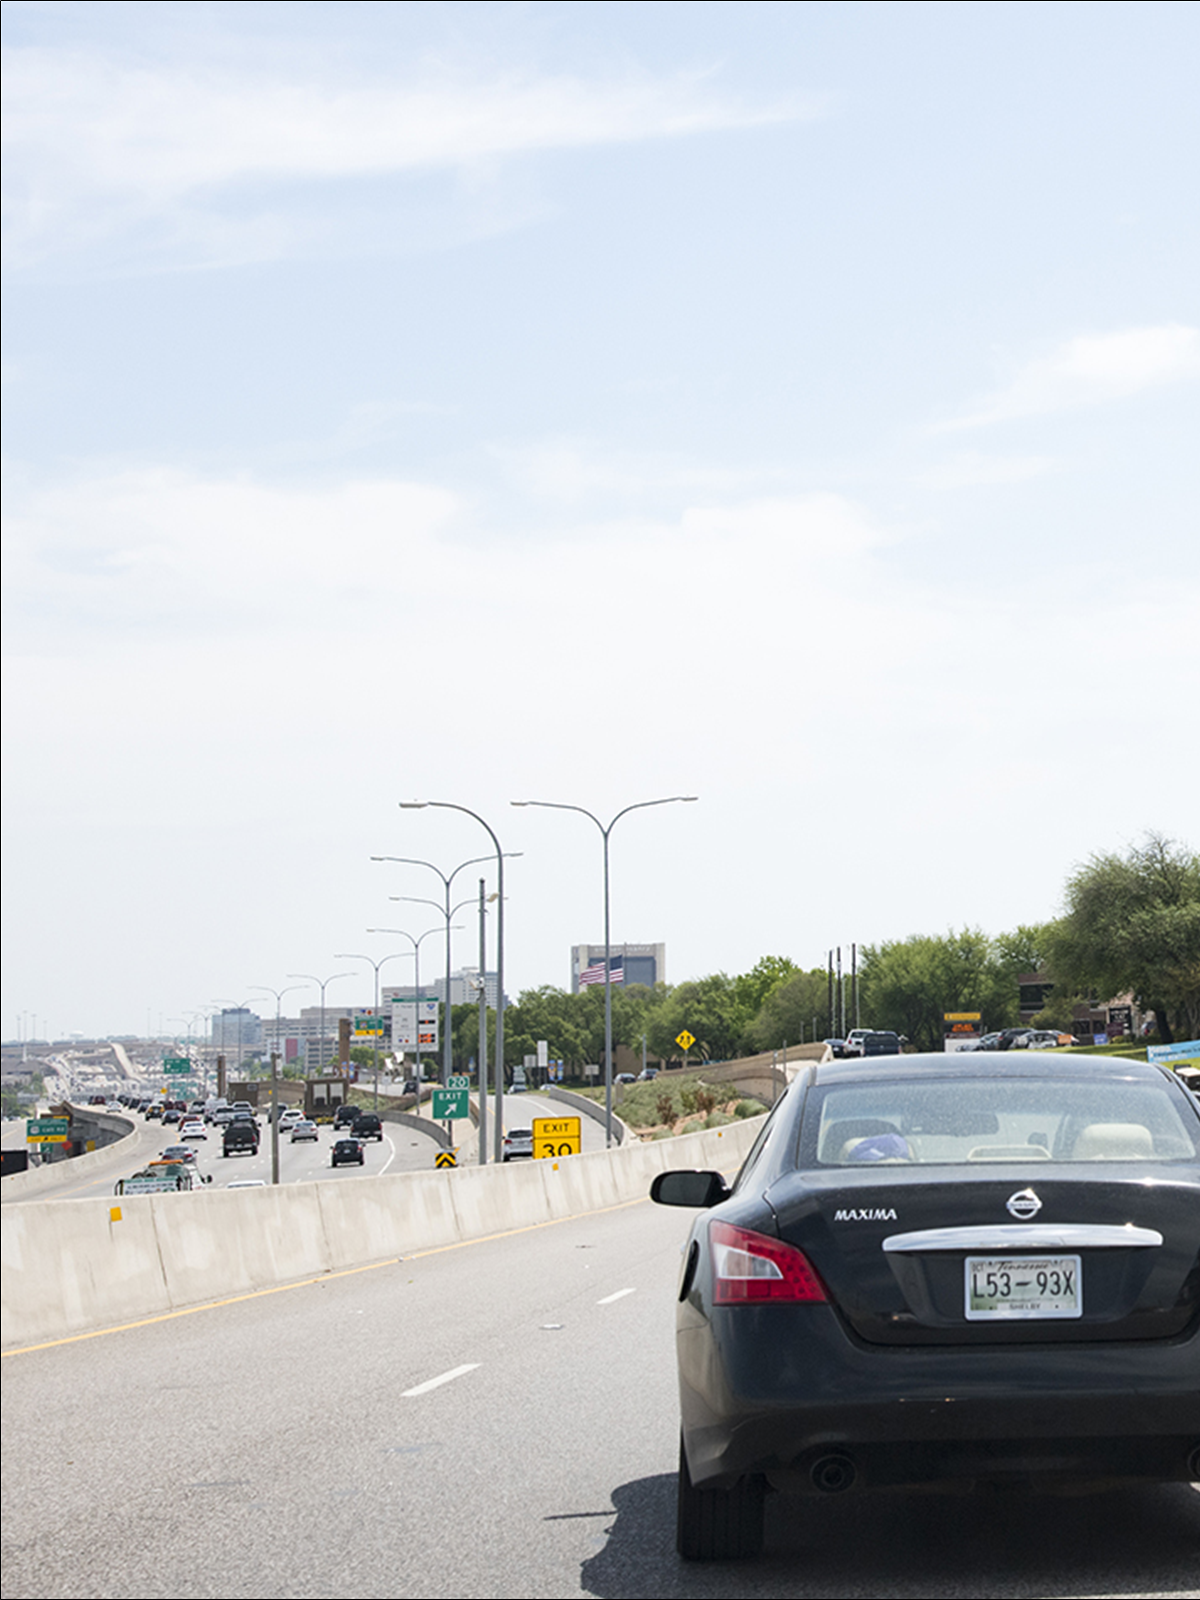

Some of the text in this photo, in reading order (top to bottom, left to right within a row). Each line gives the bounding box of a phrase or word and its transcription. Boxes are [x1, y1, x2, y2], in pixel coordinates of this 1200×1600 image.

[451, 1078, 466, 1088] 20
[438, 1092, 462, 1100] EXIT
[543, 1123, 570, 1133] EXIT
[541, 1142, 573, 1159] 30
[834, 1208, 898, 1221] MAXIMA
